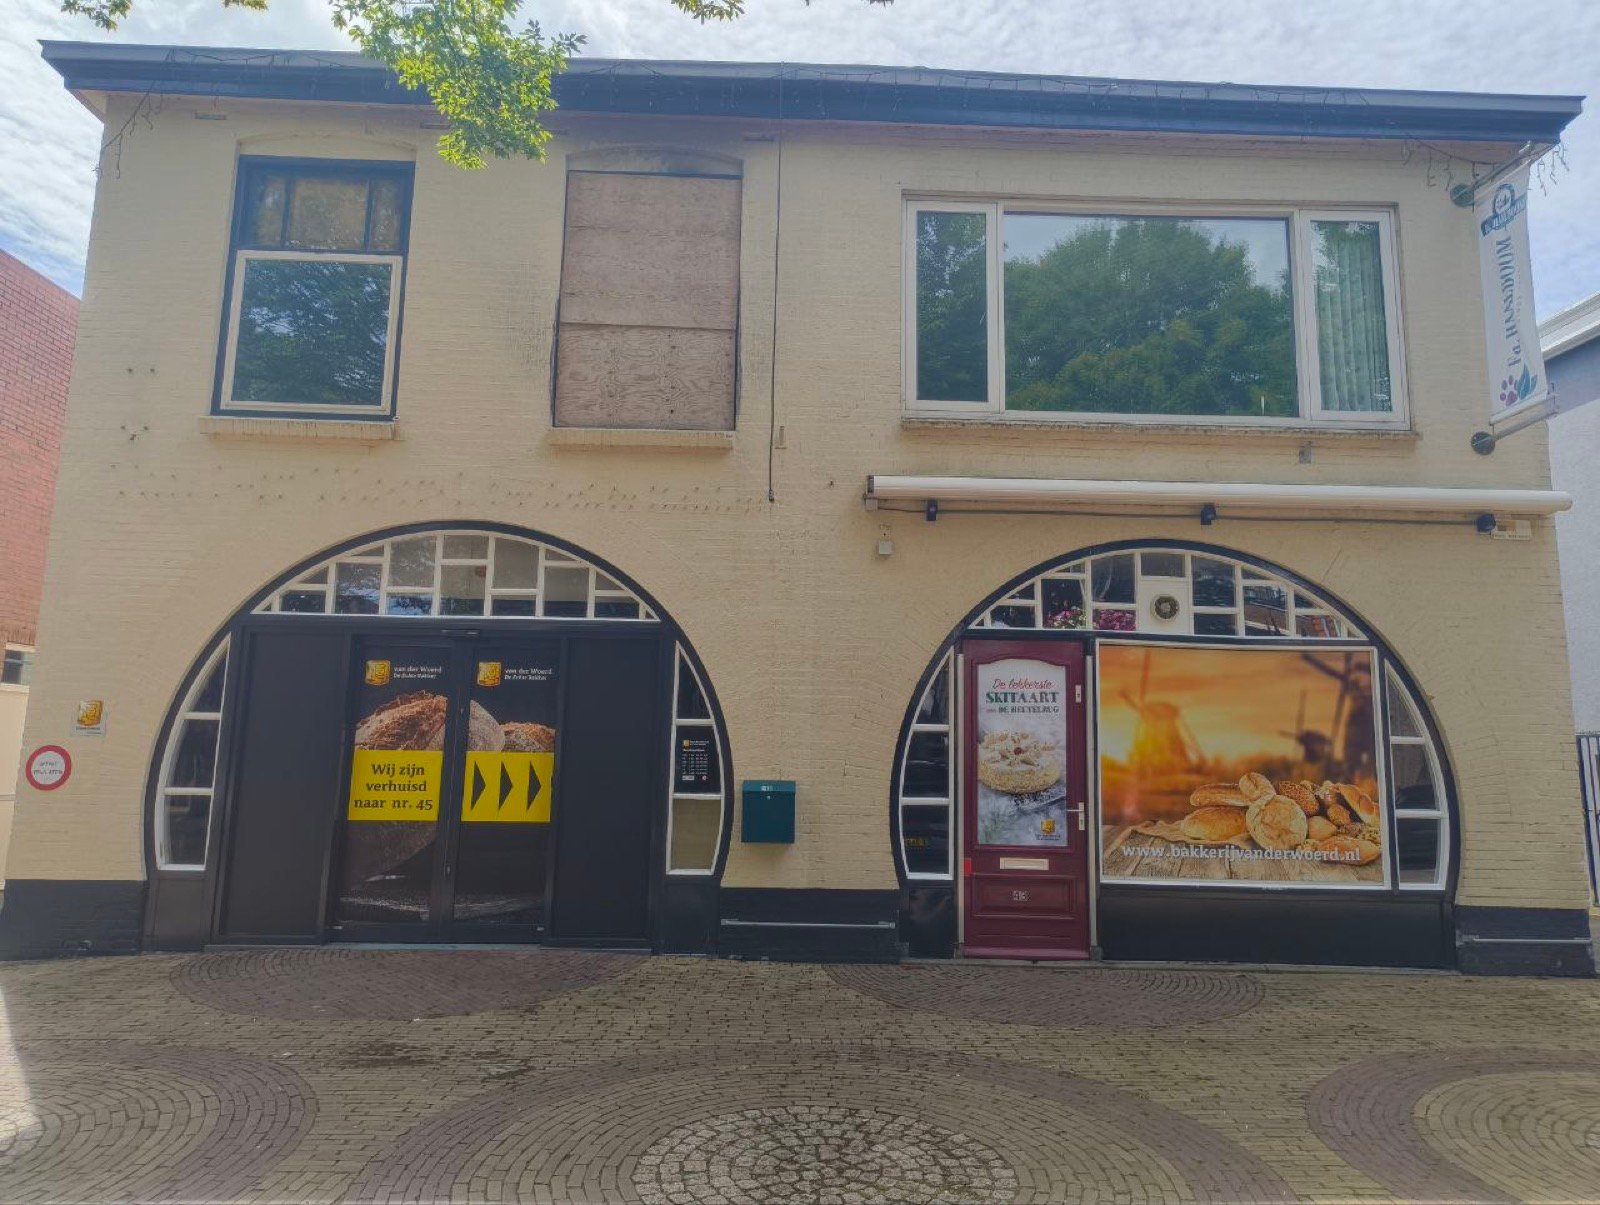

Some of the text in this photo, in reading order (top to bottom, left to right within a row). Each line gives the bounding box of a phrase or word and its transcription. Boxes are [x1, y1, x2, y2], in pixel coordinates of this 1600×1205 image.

[992, 678, 1006, 690] De
[371, 763, 425, 778] Wij zijn
[366, 780, 427, 792] verhuisd
[354, 799, 433, 811] naar nr. 45
[1122, 843, 1361, 862] www.bakkerijvanderwoerd.nl
